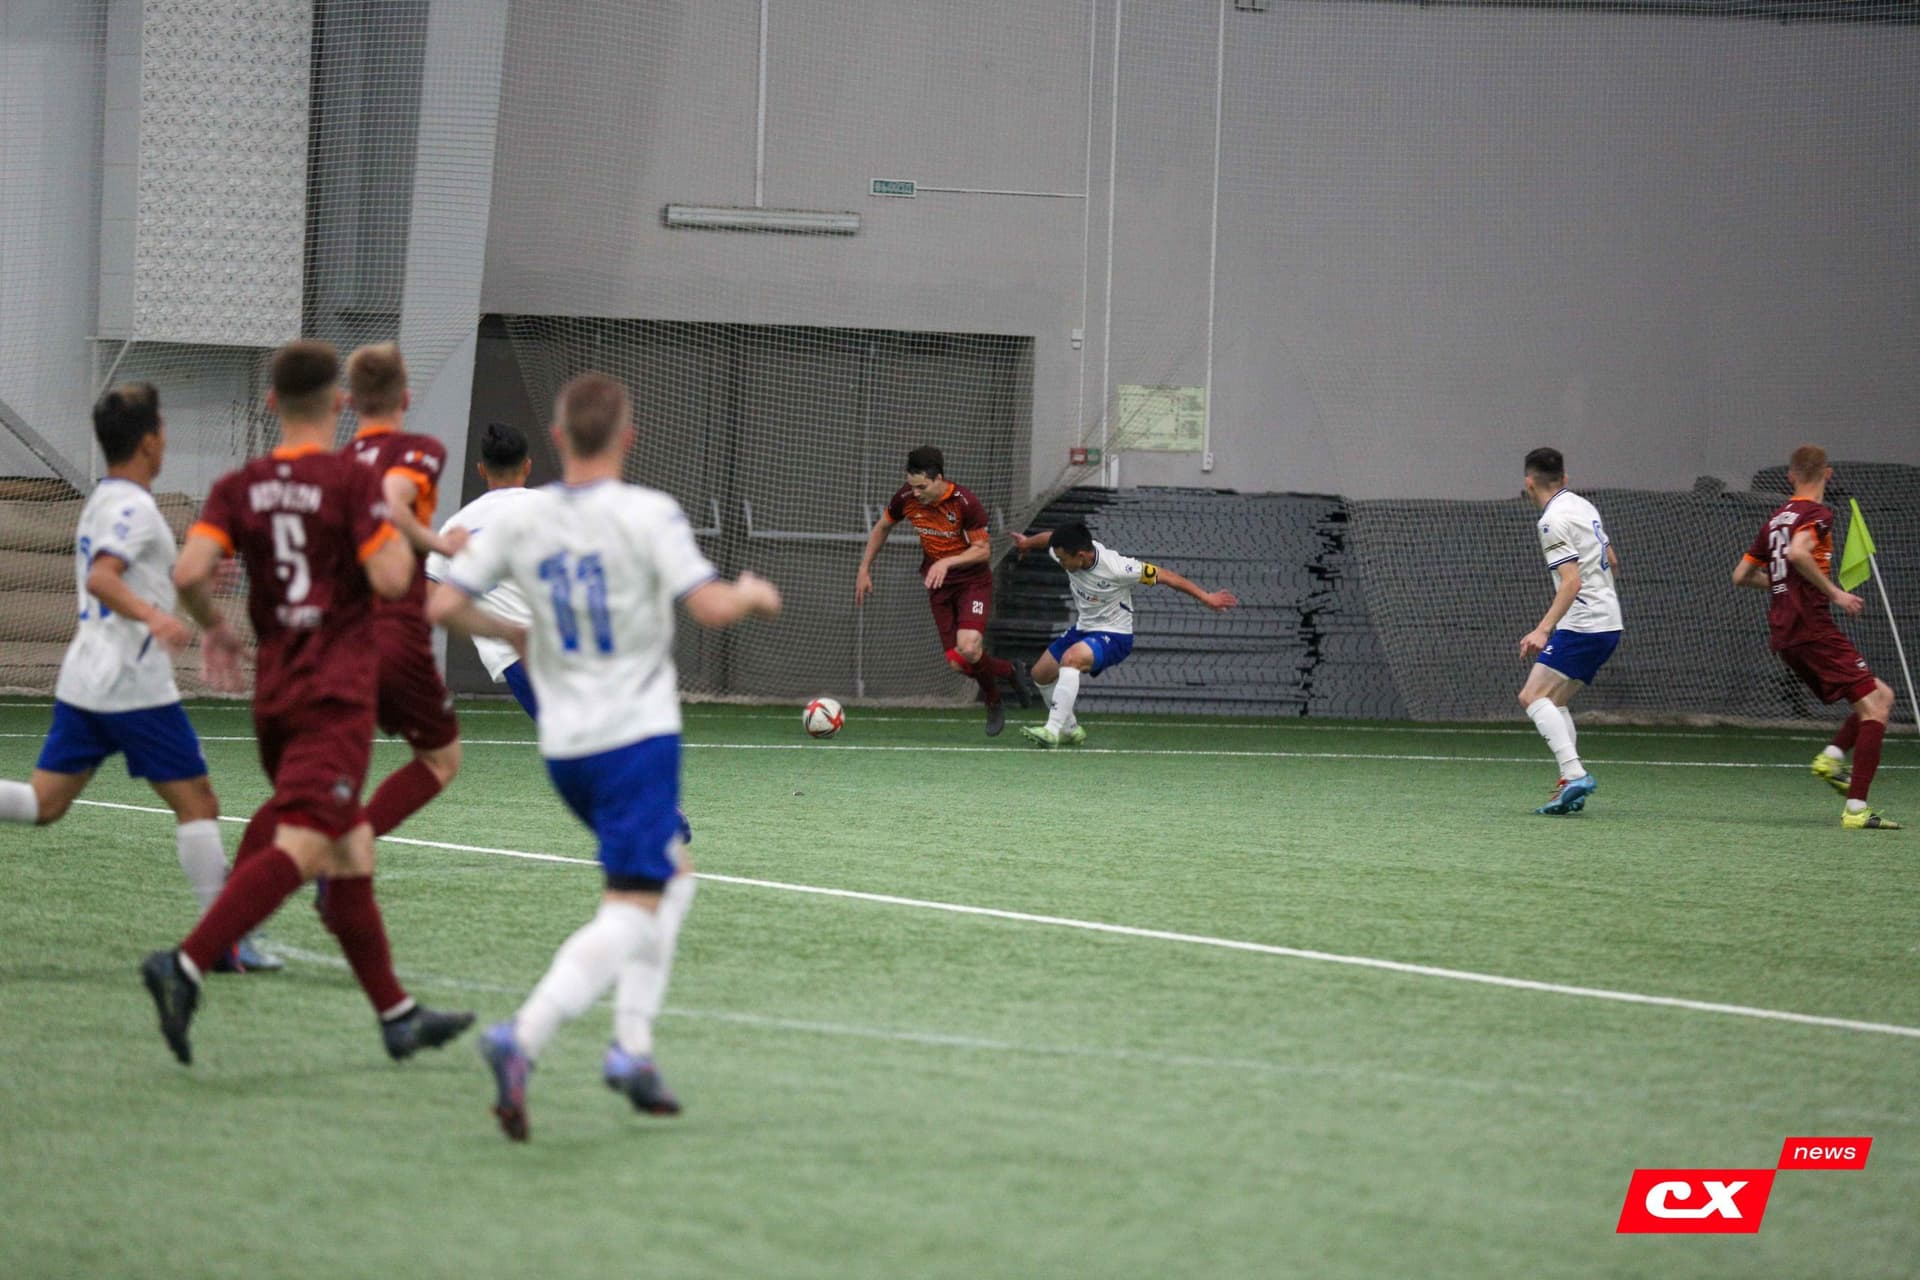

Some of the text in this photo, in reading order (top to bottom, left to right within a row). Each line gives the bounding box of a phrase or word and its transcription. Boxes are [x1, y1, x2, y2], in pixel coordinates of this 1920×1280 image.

[272, 513, 312, 603] 5
[538, 549, 614, 654] 11
[972, 600, 984, 615] 23
